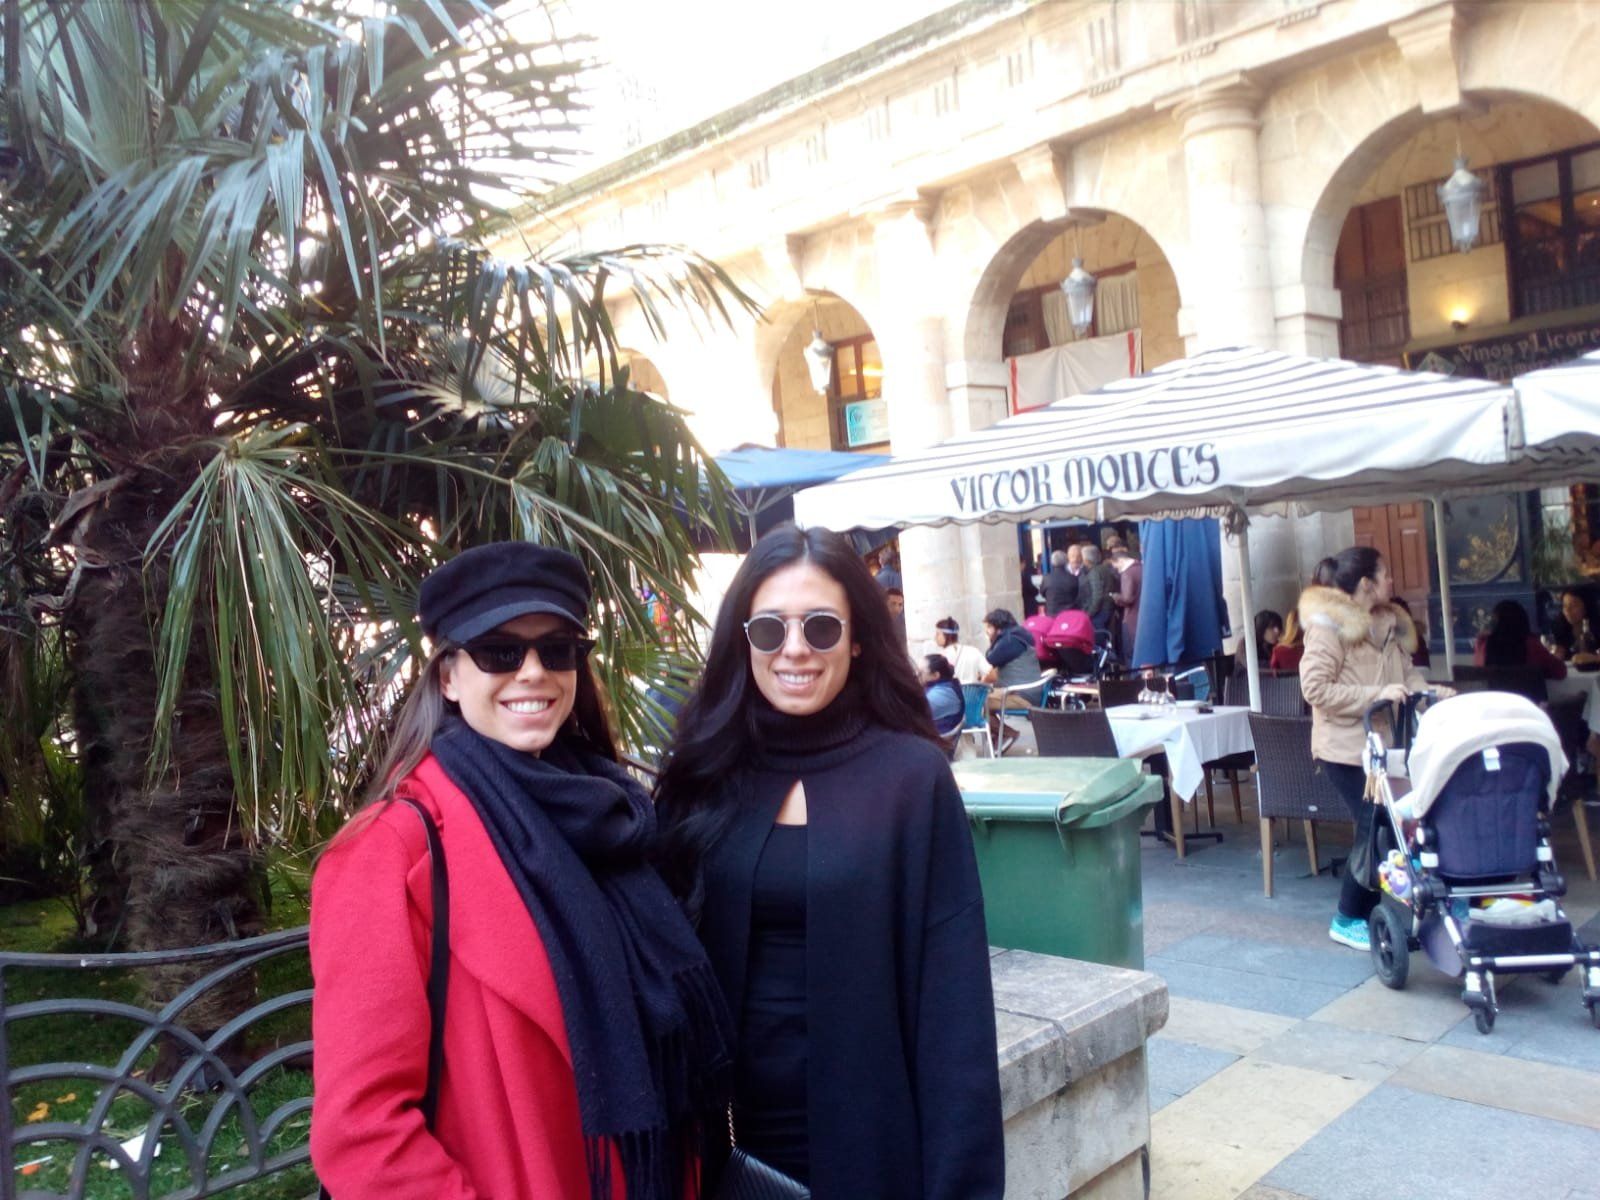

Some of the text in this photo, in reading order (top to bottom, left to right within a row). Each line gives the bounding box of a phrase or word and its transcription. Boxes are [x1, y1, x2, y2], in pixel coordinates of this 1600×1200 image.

[1458, 343, 1514, 363] Vinos
[950, 442, 1221, 513] VICTOR MONTES
